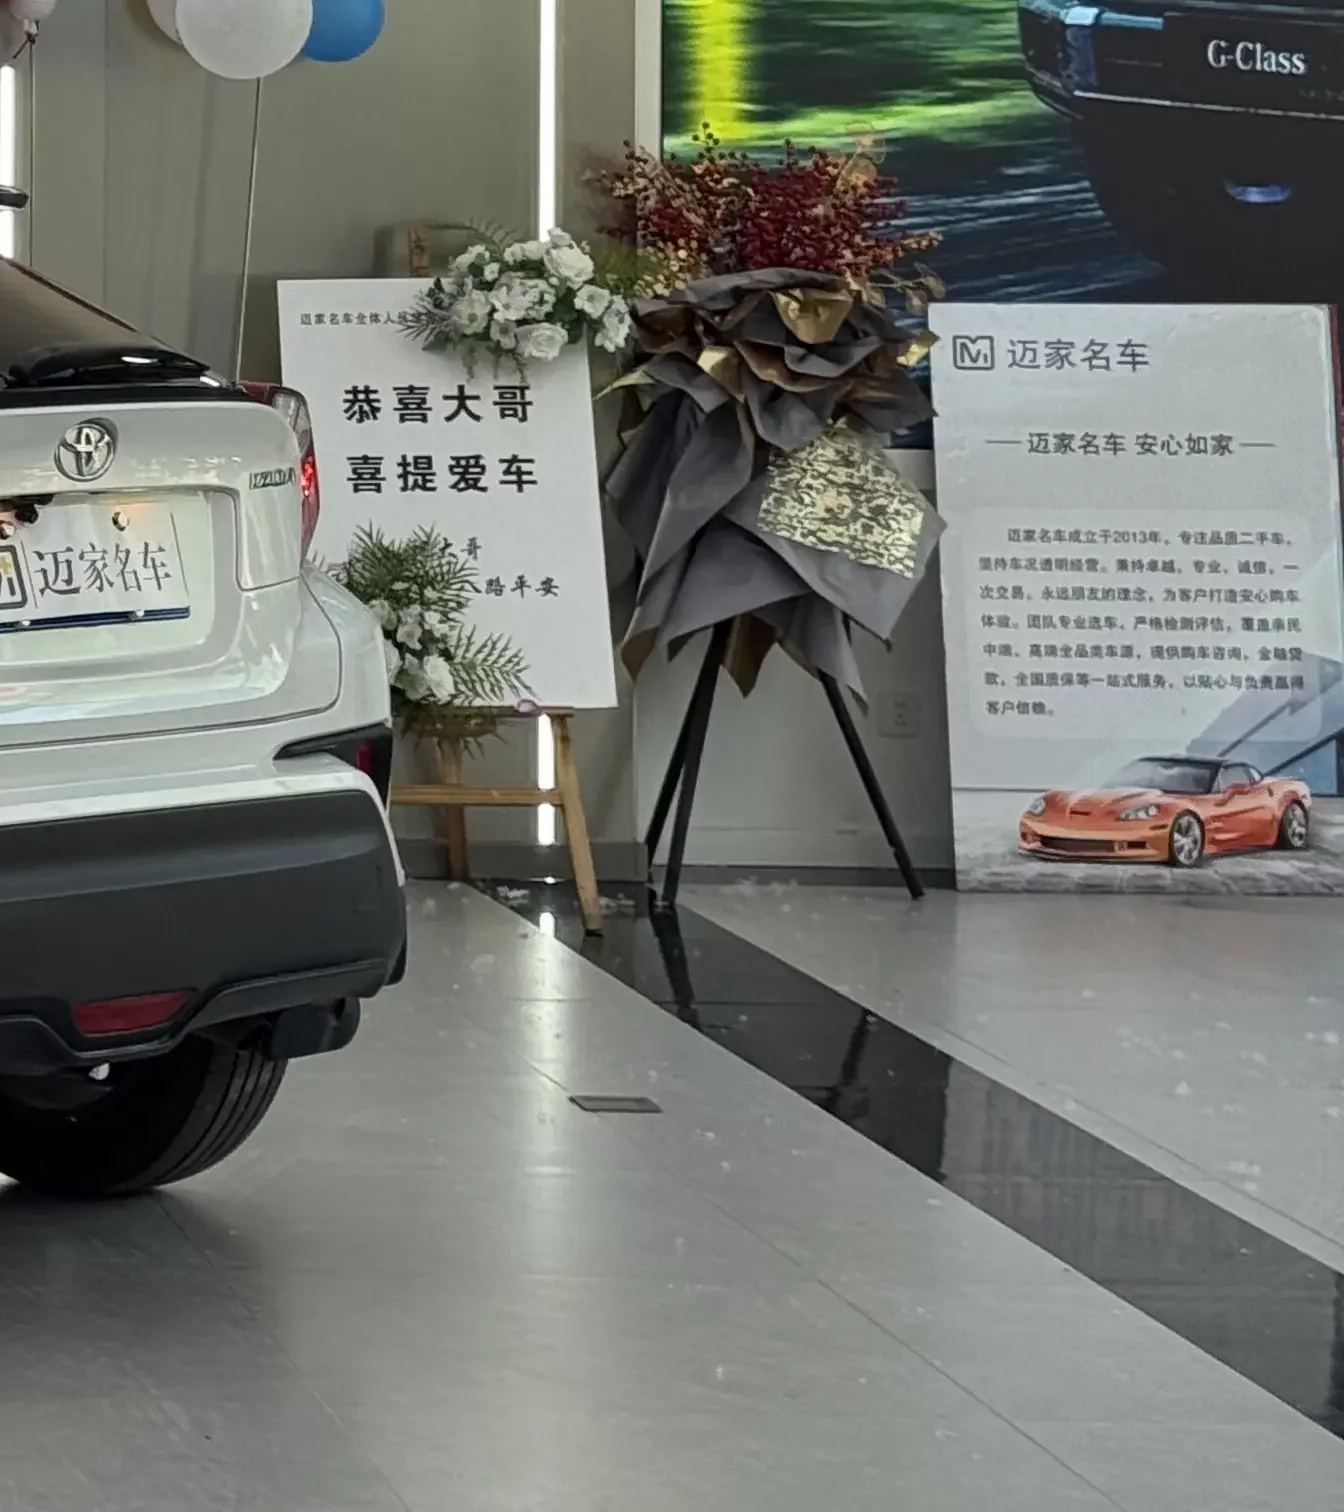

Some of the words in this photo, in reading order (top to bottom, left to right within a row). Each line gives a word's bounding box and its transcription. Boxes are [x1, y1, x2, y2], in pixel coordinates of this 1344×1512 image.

[1207, 39, 1308, 75] G-Class
[1007, 338, 1150, 373] 迈家名车
[342, 384, 534, 424] 恭喜大哥
[1027, 432, 1127, 456] 迈家名车
[1134, 433, 1235, 457] 安心如家
[346, 454, 538, 494] 喜提爱车
[32, 541, 173, 598] 迈家名车
[457, 575, 560, 599] 路平安
